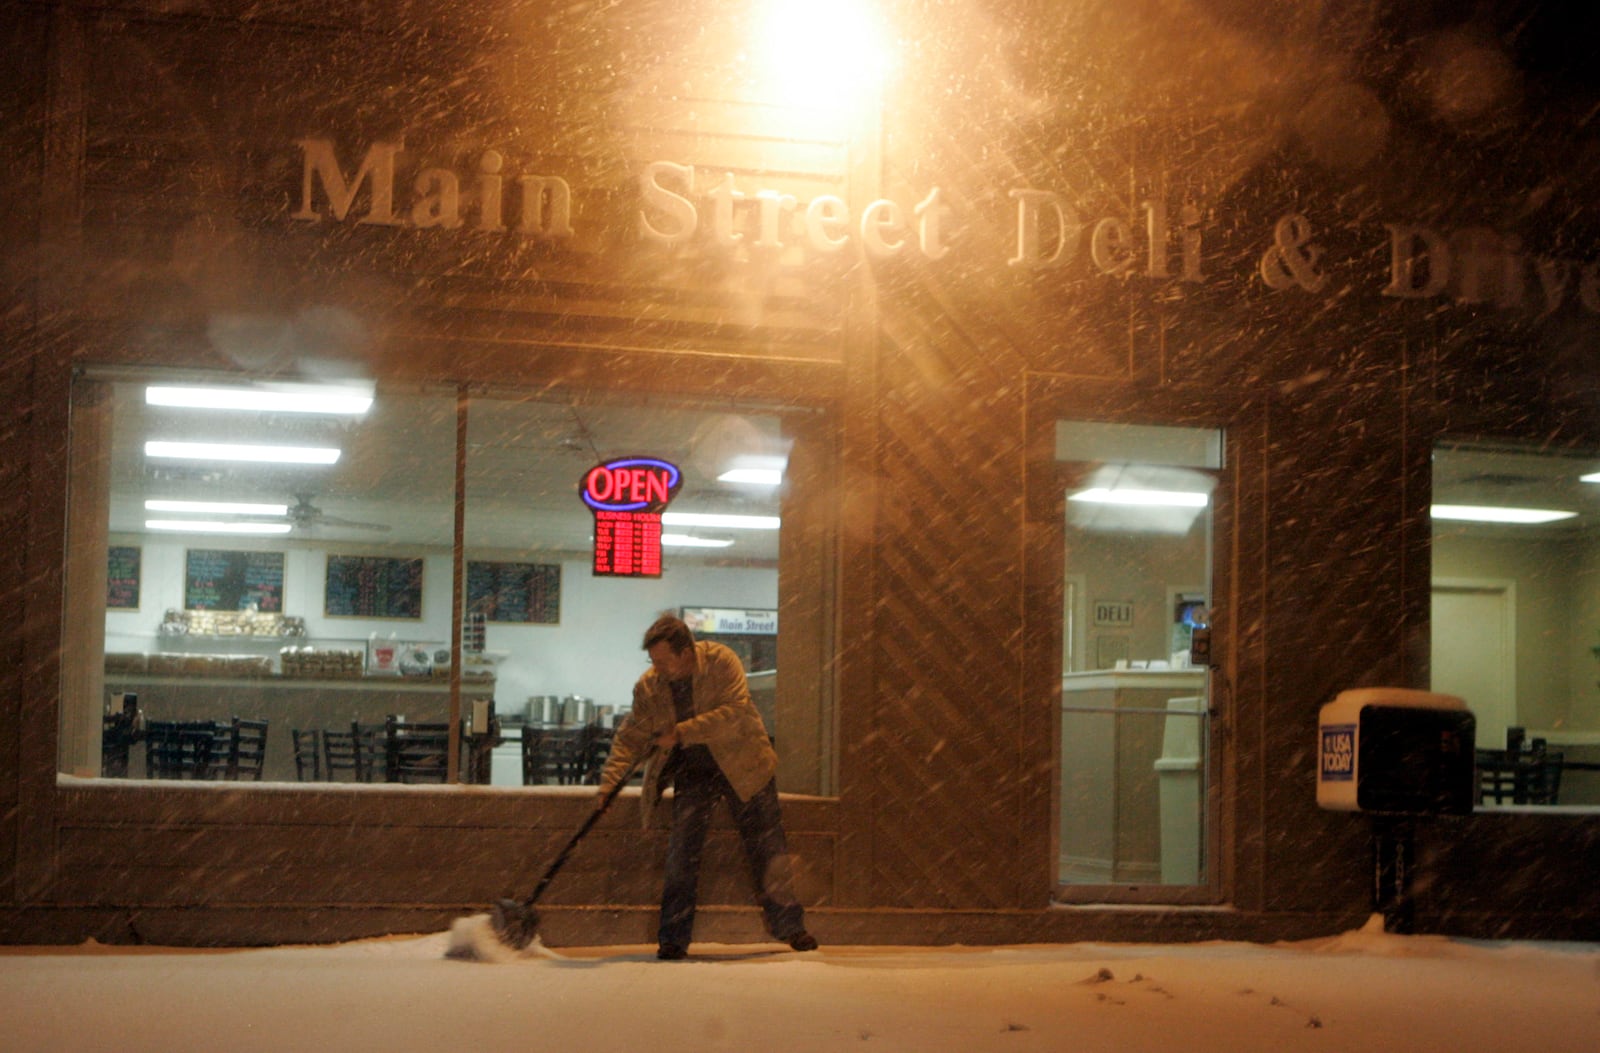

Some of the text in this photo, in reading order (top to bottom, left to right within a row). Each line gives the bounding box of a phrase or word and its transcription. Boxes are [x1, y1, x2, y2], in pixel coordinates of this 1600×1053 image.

[291, 137, 576, 238] Main
[638, 160, 951, 260] Street
[1006, 188, 1200, 284] Deli
[1260, 212, 1330, 295] &
[588, 466, 669, 503] OPEN
[1097, 605, 1130, 622] DELI
[719, 617, 775, 632] Main Street
[1332, 733, 1352, 753] USA
[1323, 752, 1352, 772] TODAY
